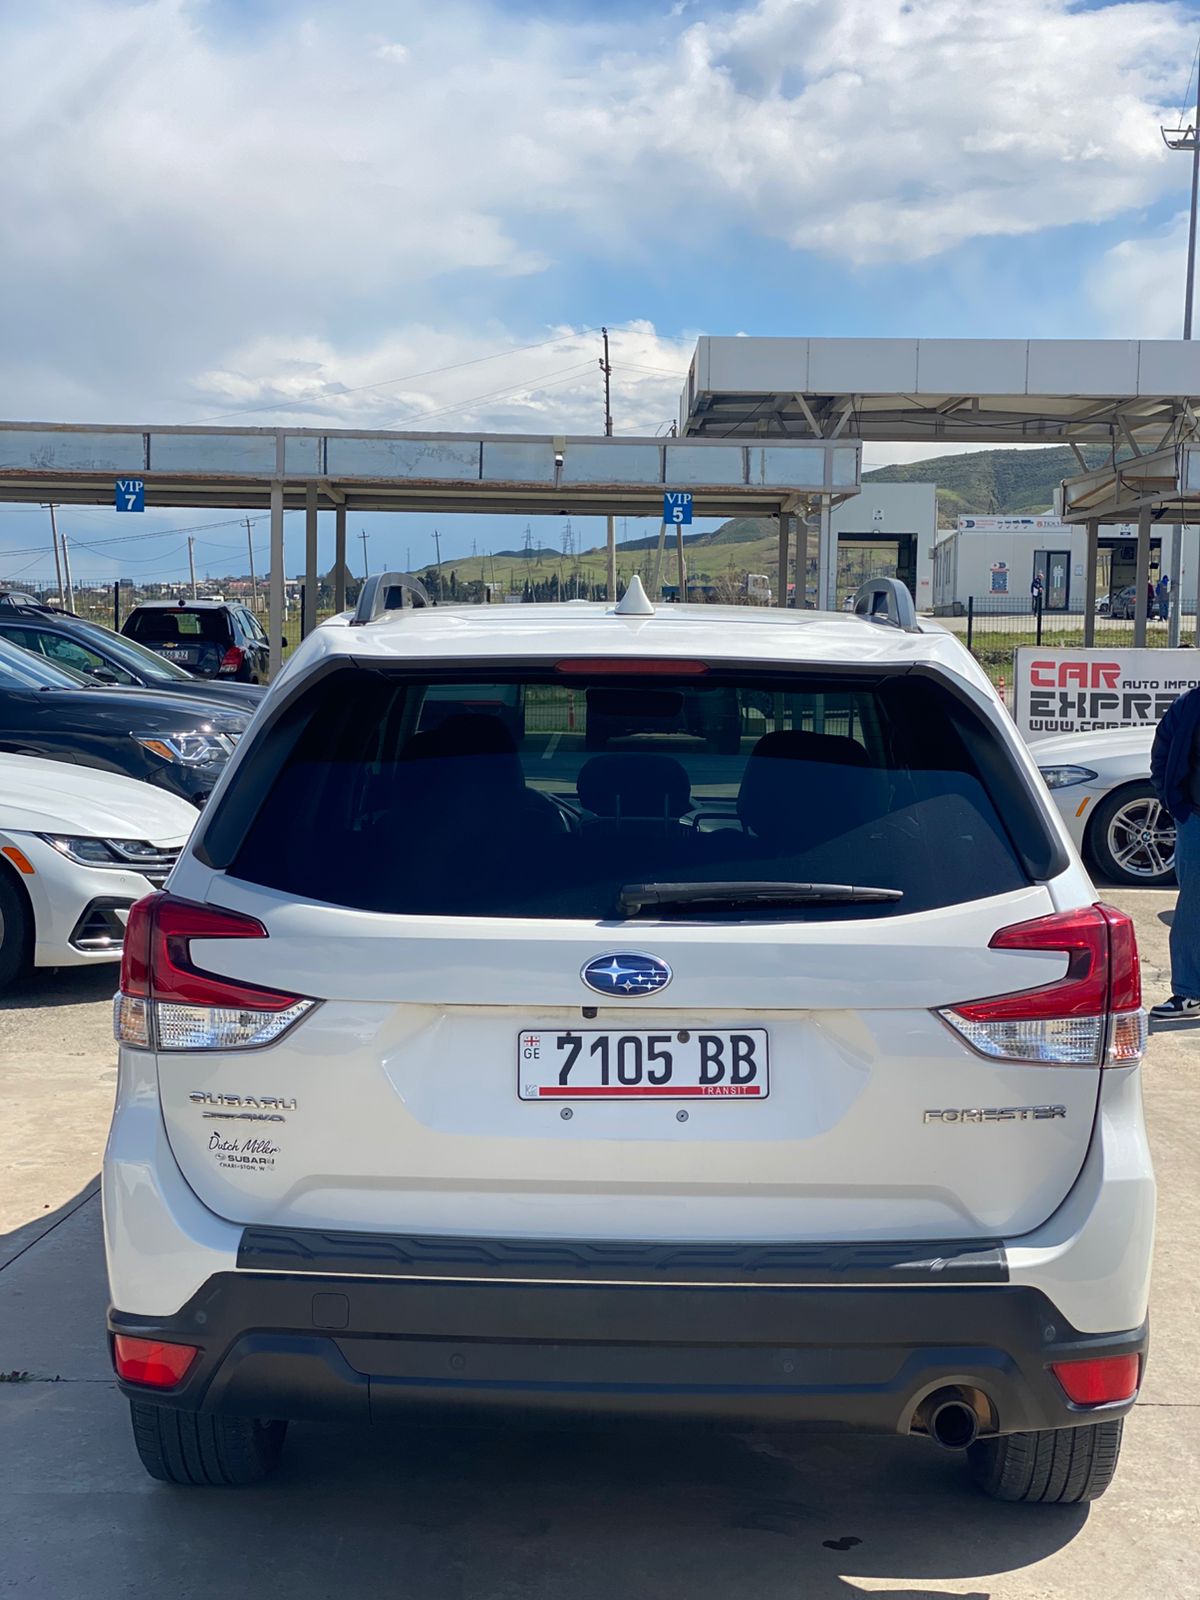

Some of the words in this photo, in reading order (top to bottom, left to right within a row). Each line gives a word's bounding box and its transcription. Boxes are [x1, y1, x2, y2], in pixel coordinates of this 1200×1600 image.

[116, 480, 144, 492] VIP
[124, 494, 137, 510] 7
[665, 493, 692, 505] VIP
[672, 506, 684, 523] 5
[1030, 661, 1121, 689] CAR
[1122, 680, 1159, 690] AUTO
[523, 1048, 540, 1060] GE
[556, 1035, 673, 1086] 7105
[698, 1034, 758, 1085] BB
[700, 1086, 748, 1096] TRANSIT
[189, 1090, 297, 1111] SUBARU
[923, 1104, 1067, 1124] FORESTER
[208, 1133, 239, 1151] Dutch
[241, 1139, 279, 1155] Miller
